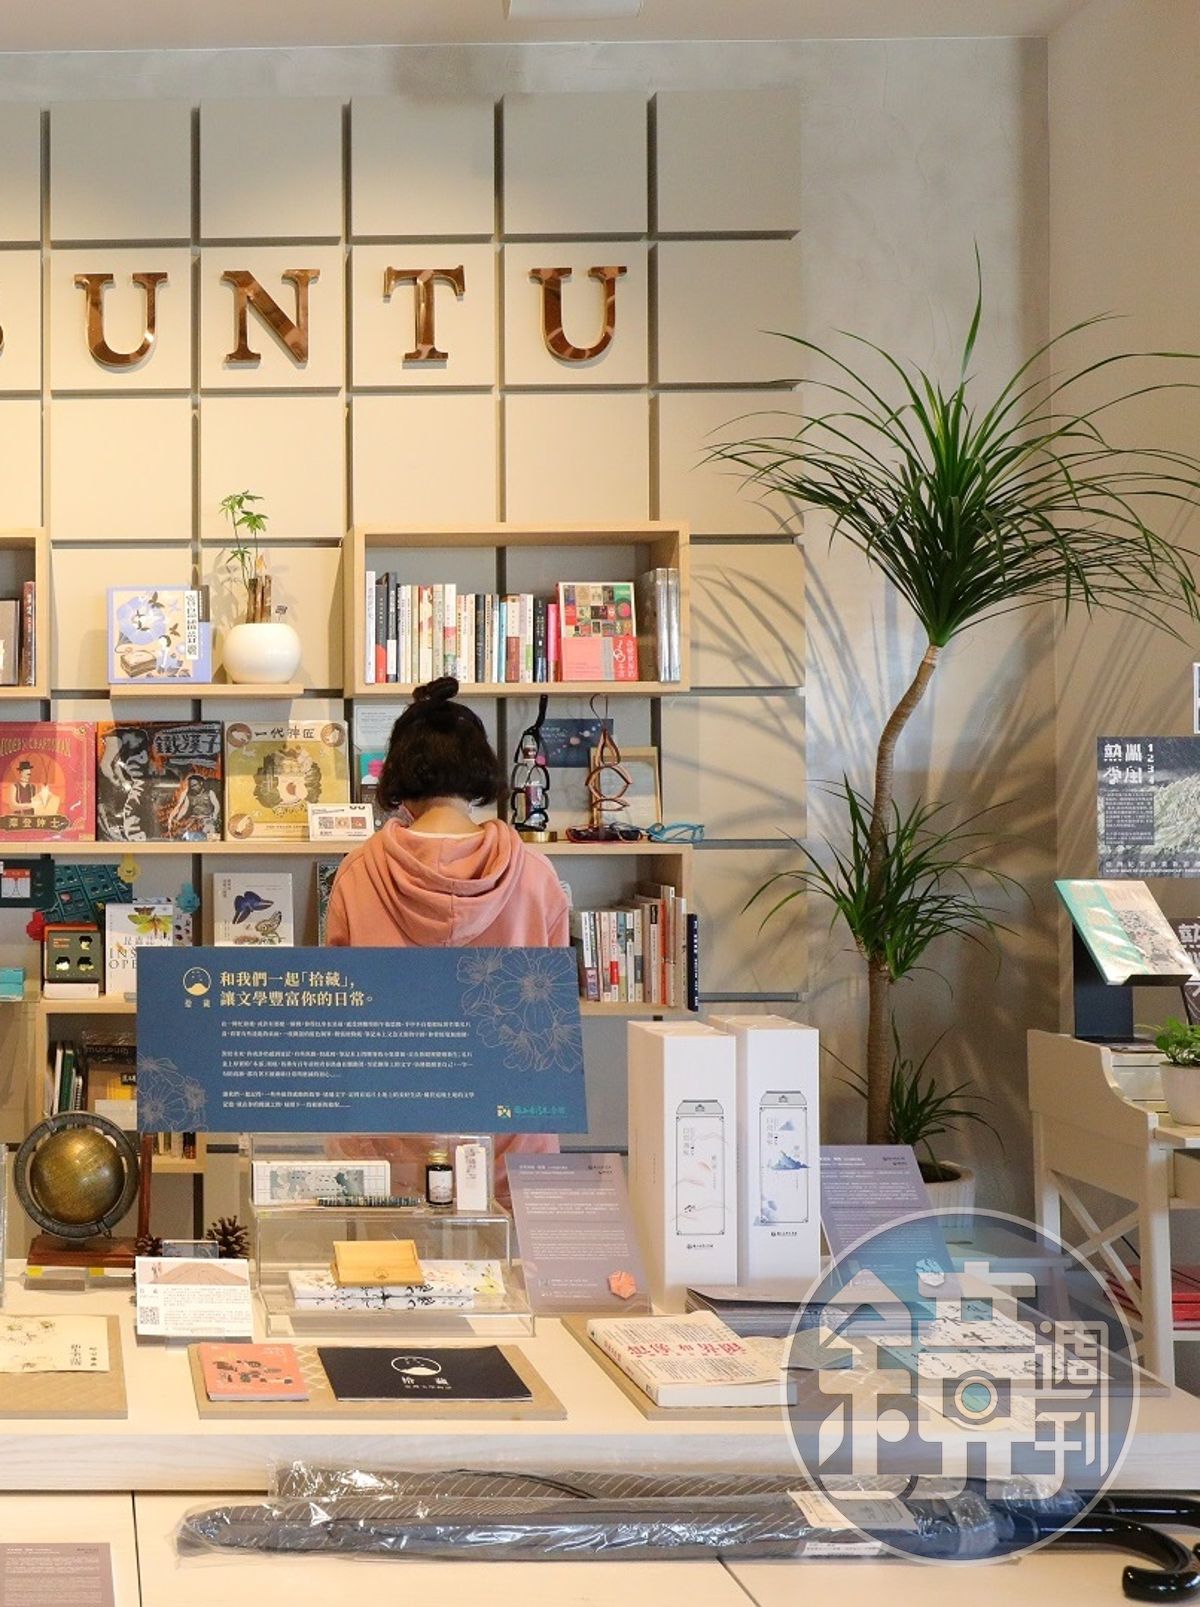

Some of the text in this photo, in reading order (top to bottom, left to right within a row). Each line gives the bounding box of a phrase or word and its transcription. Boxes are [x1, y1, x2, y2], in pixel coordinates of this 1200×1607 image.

[220, 991, 373, 1007] 讓文學豐富你的日常。
